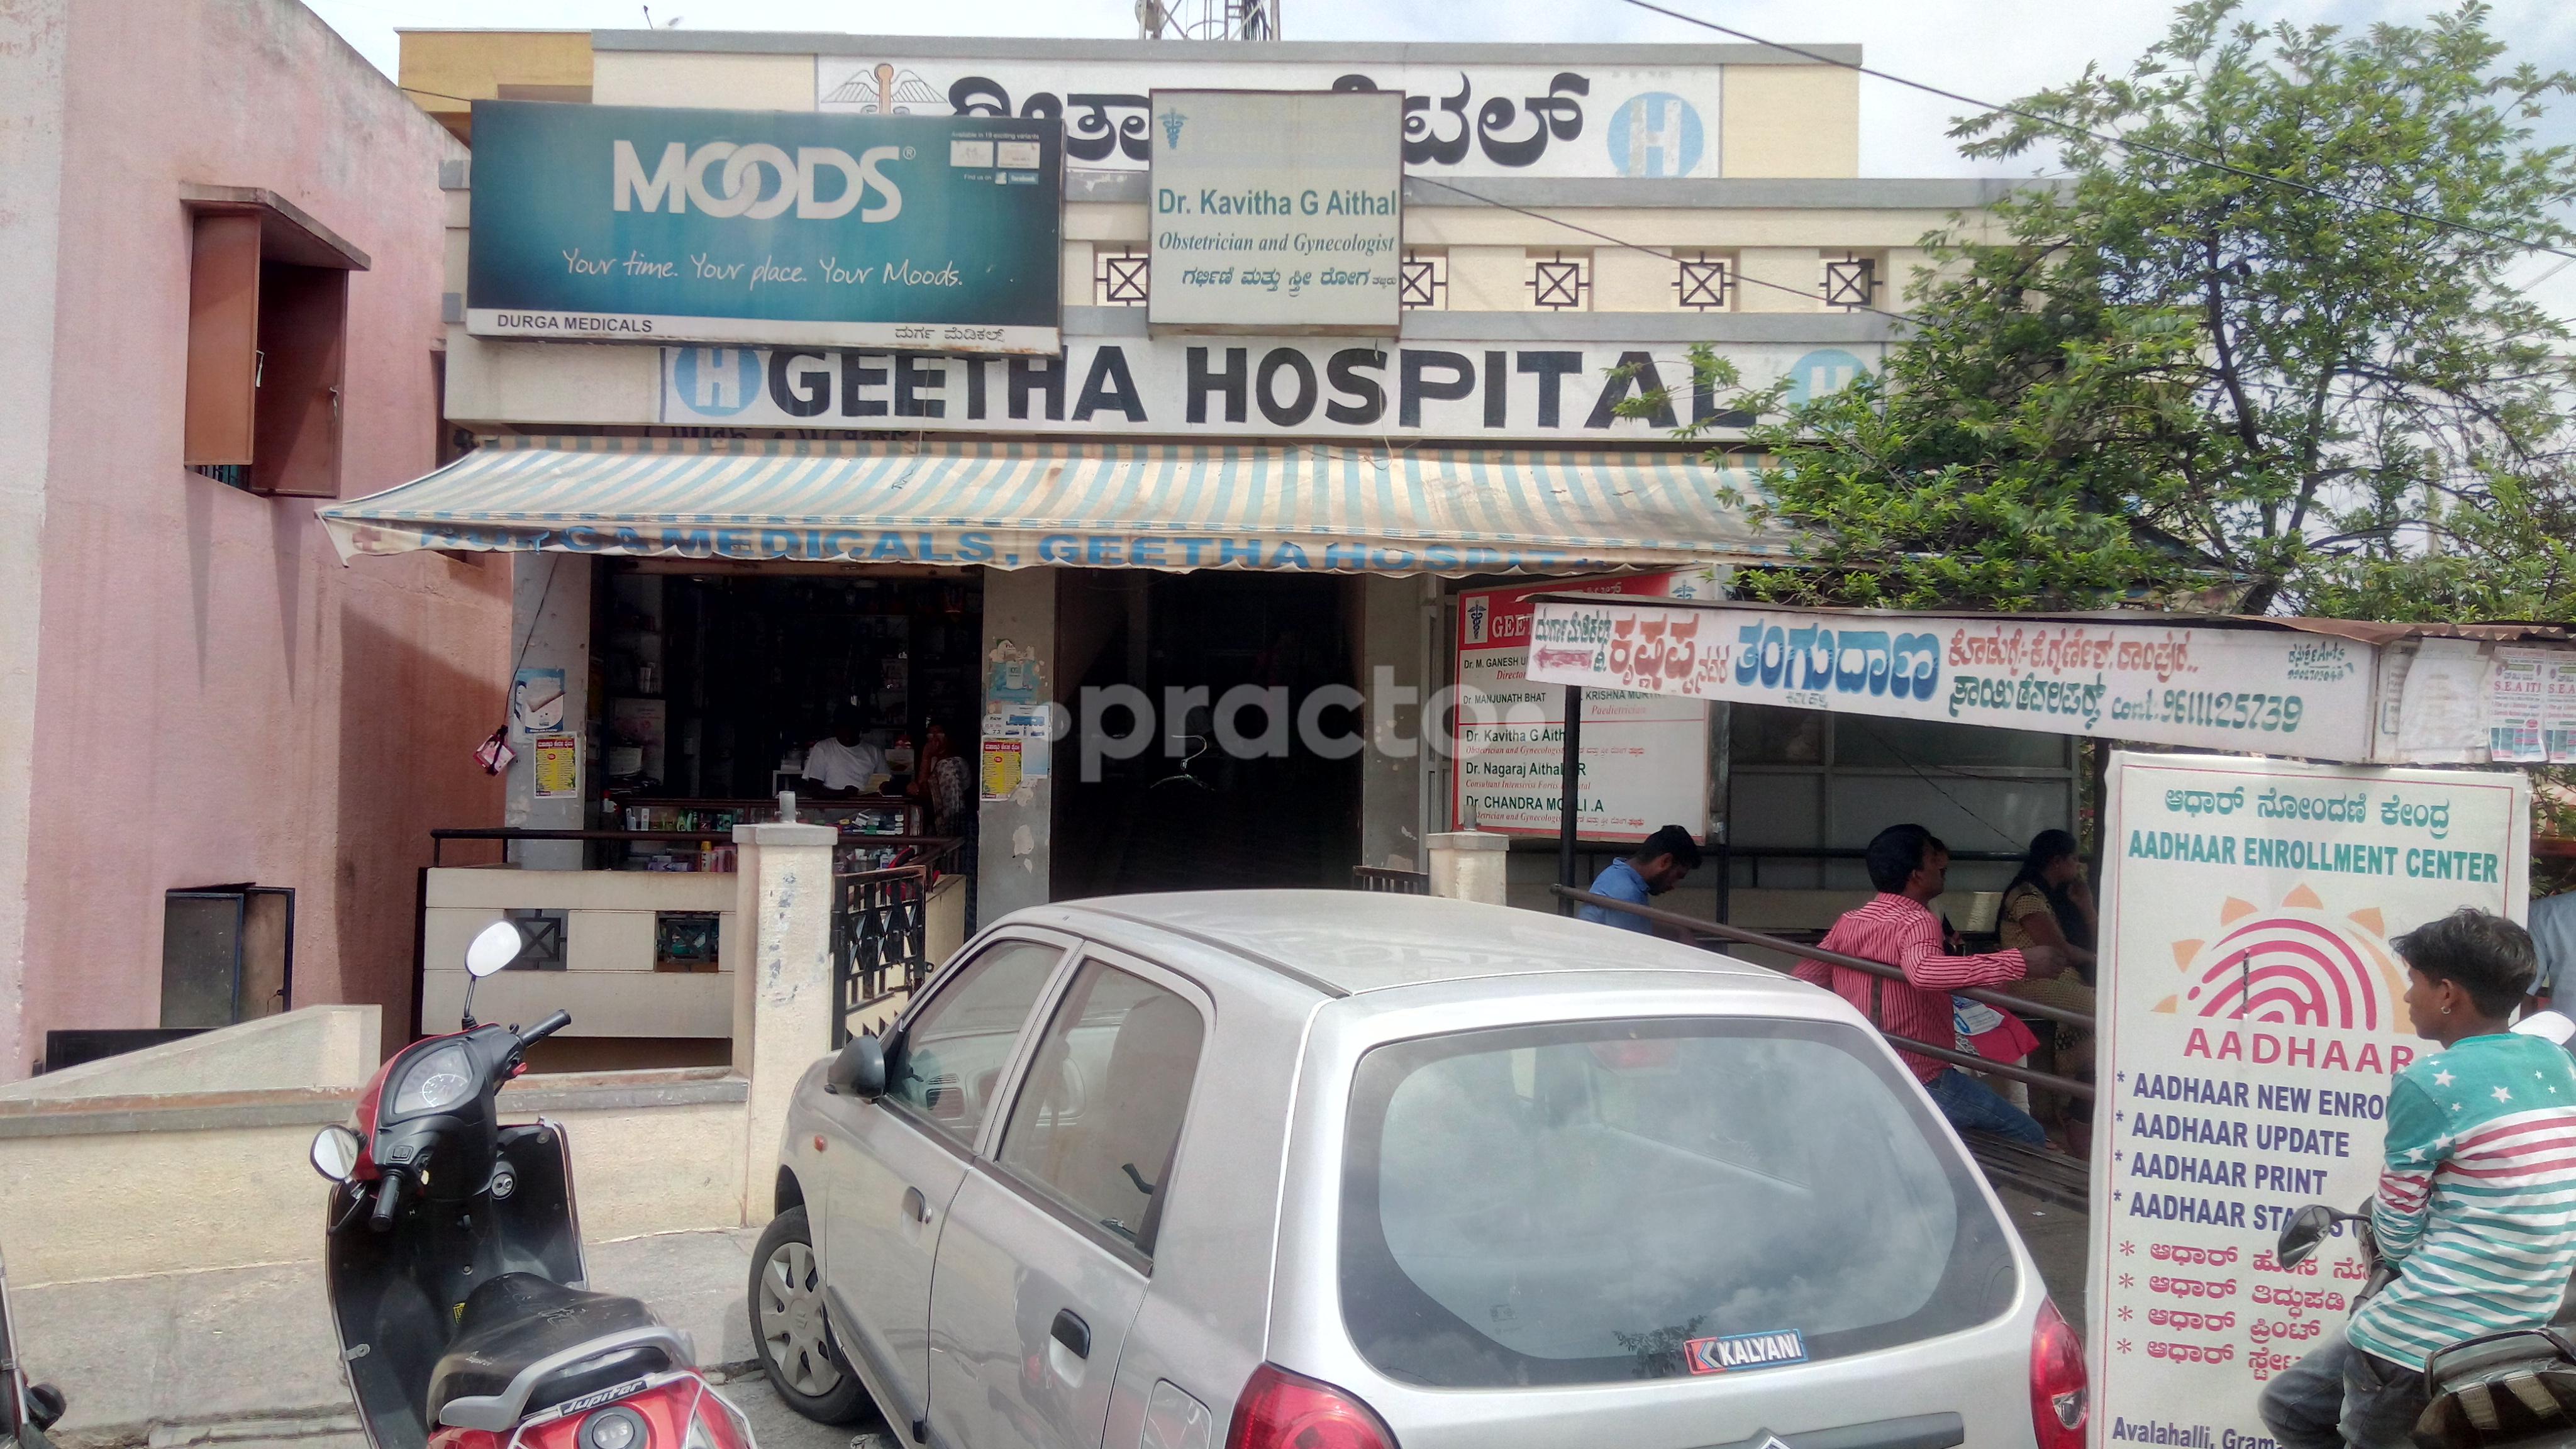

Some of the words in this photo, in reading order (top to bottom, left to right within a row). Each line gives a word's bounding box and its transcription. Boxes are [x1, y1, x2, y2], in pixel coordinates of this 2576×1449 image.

[1158, 189, 1191, 214] Dr.
[1201, 190, 1292, 215] Kavitha
[1300, 191, 1319, 216] G
[1326, 190, 1396, 216] Aithal
[1159, 233, 1252, 252] Obstetrician
[1259, 233, 1287, 252] and
[1294, 233, 1394, 255] Gynecologist
[563, 248, 616, 276] Your
[623, 250, 677, 277] time.
[691, 252, 745, 281] Your
[750, 258, 807, 290] place.
[819, 255, 872, 285] Your
[883, 259, 963, 287] Moods.
[497, 314, 558, 331] DURGA
[564, 316, 652, 333] MEDICALS
[768, 345, 1148, 422] GEETHA
[1185, 347, 1757, 429] HOSPITAL
[1486, 657, 1518, 668] GANESH
[1475, 693, 1522, 704] MANJUNATH
[1524, 692, 1546, 702] BHAT
[1586, 690, 1626, 701] KRISHNA
[1484, 729, 1525, 742] Kavitha
[1530, 729, 1538, 742] G
[1542, 728, 1565, 742] Aith
[1466, 762, 1480, 774] Dr.
[1484, 762, 1526, 777] Nagaraj
[1484, 796, 1543, 810] CHANDRA
[2165, 786, 2245, 816] ಆಧಾರ್
[2258, 787, 2367, 823] ನೋಂದಣಿ
[2380, 794, 2450, 840] ಕೇಂದ್ರ
[2129, 830, 2236, 865] AADHAAR
[2244, 838, 2398, 876] ENROLLMENT
[2406, 848, 2499, 884] CENTER
[2183, 1028, 2414, 1075] AADHAAR
[2133, 1073, 2250, 1108] AADHAAR
[2258, 1084, 2312, 1113] NEW
[2319, 1091, 2389, 1121] ENRO
[2132, 1112, 2248, 1148] AADHAAR
[2257, 1124, 2350, 1158] UPDATE
[2131, 1152, 2246, 1188] AADHAAR
[2255, 1165, 2328, 1196] PRINT
[2129, 1191, 2246, 1228] AADHAAR
[2150, 1242, 2238, 1268] ಆಧಾರ್
[2149, 1274, 2236, 1300] ಆಧಾರ್
[2251, 1284, 2346, 1319] ತಿದ್ದುಪಡಿ
[2148, 1307, 2235, 1333] ಆಧಾರ್
[2250, 1318, 2321, 1345] ಪ್ರಿಂಟ್
[1716, 1332, 1802, 1366] KALYANI
[2147, 1339, 2234, 1365] ಆಧಾರ್
[563, 1381, 643, 1414] Jupiter
